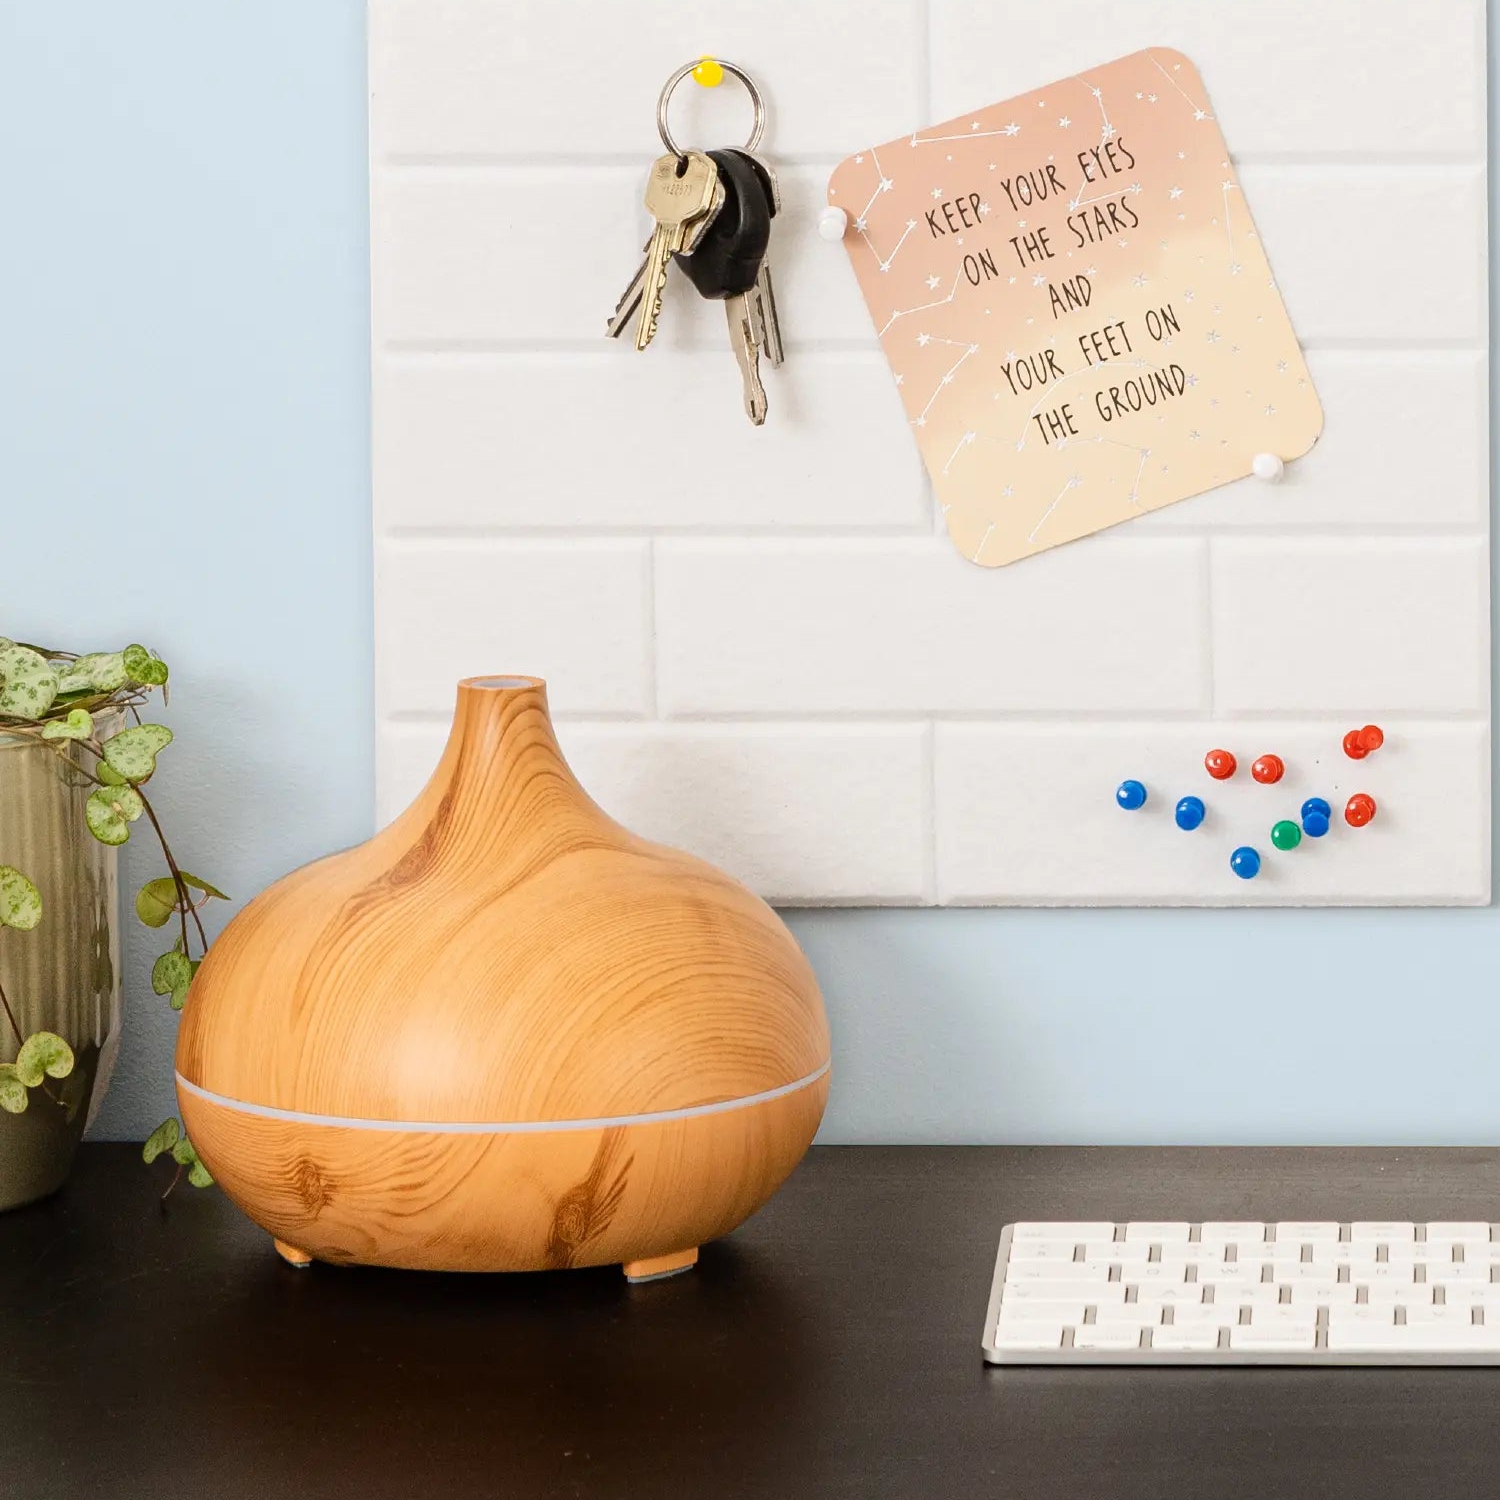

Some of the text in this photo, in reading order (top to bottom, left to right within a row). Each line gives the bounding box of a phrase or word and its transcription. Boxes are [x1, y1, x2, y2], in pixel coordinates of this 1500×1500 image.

[925, 136, 1136, 240] KEEP YOUR EYES
[963, 196, 1140, 287] ON THE STARS
[1047, 274, 1093, 319] AND
[1000, 302, 1181, 396] YOUR FEET ON
[1033, 363, 1187, 445] THE GROUND
